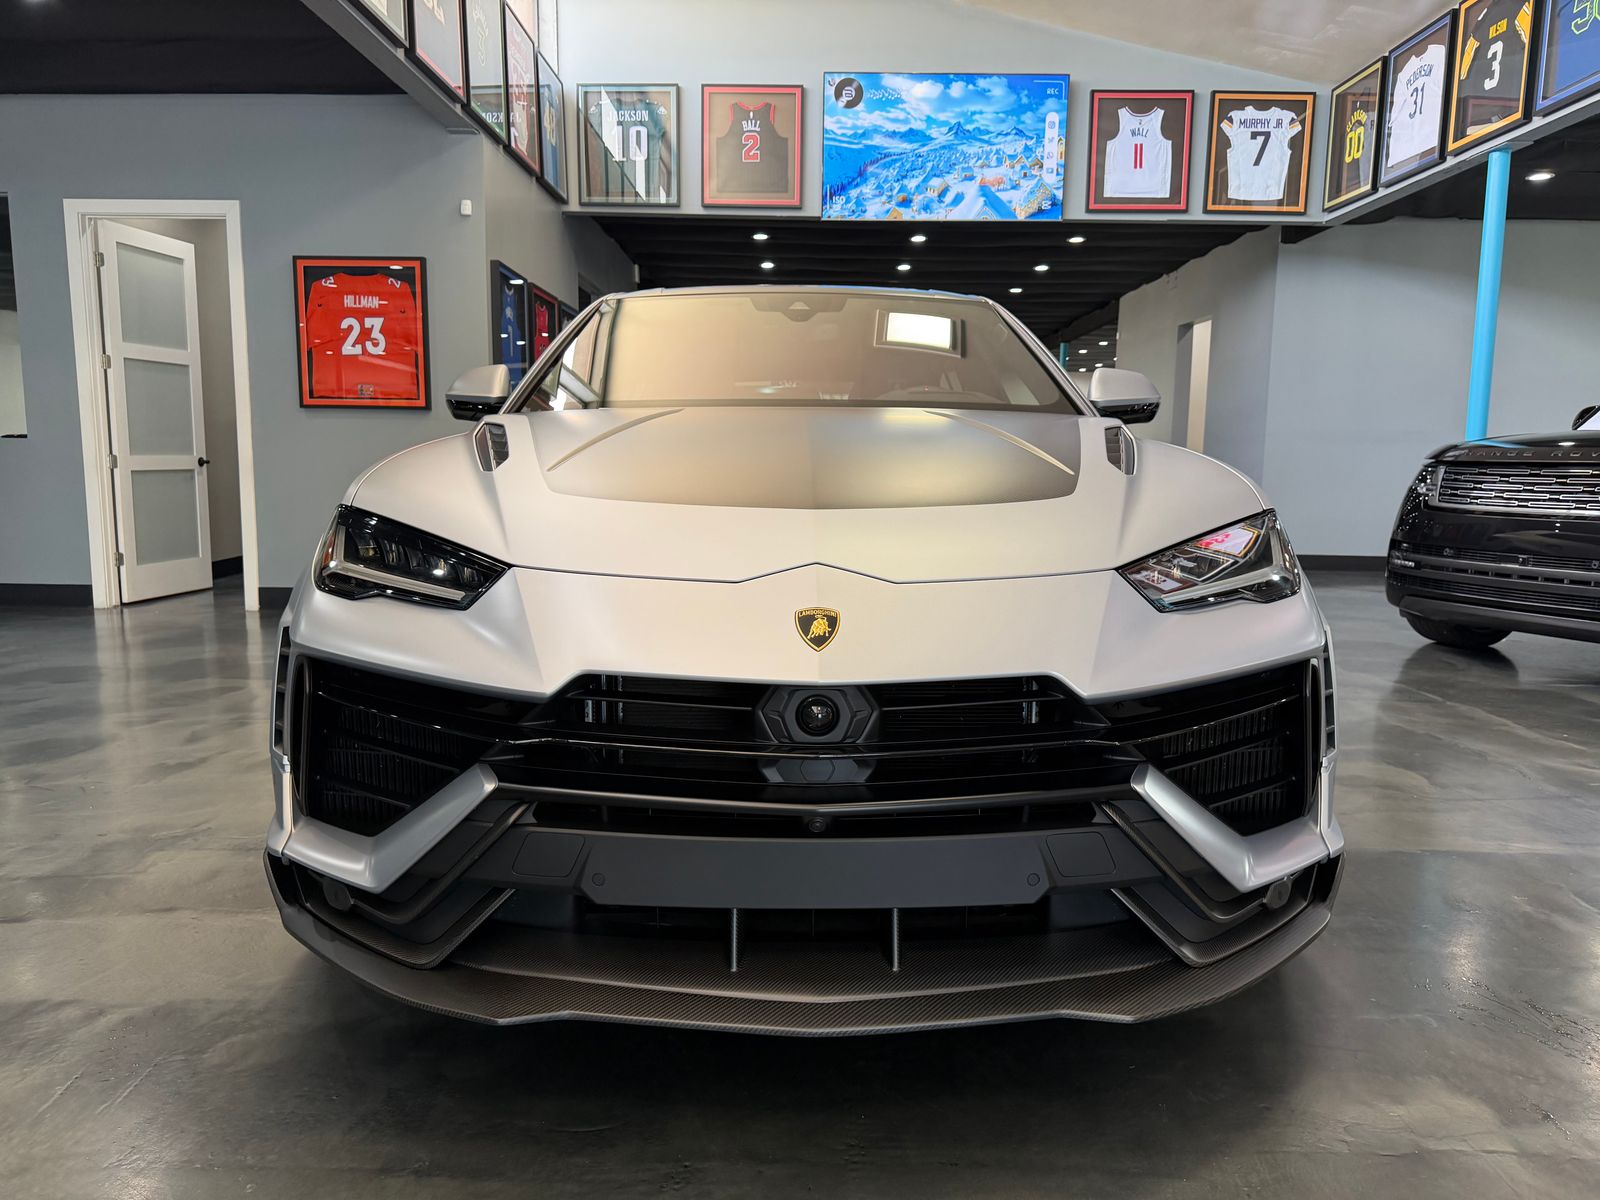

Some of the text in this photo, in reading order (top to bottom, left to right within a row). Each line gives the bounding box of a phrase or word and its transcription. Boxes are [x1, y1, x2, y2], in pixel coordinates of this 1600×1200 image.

[1484, 40, 1504, 90] 3
[1046, 87, 1059, 95] REC
[1409, 81, 1426, 120] 31
[609, 110, 649, 122] JACKSON
[742, 119, 760, 131] BALL
[1238, 117, 1284, 129] MURPHY JR
[611, 125, 648, 162] 10
[1130, 127, 1150, 138] WALL
[1345, 126, 1365, 163] 00
[742, 132, 760, 162] 2
[1133, 143, 1144, 170] 11
[1250, 130, 1271, 167] 7
[344, 294, 379, 309] HILLMAN
[340, 317, 386, 356] 23
